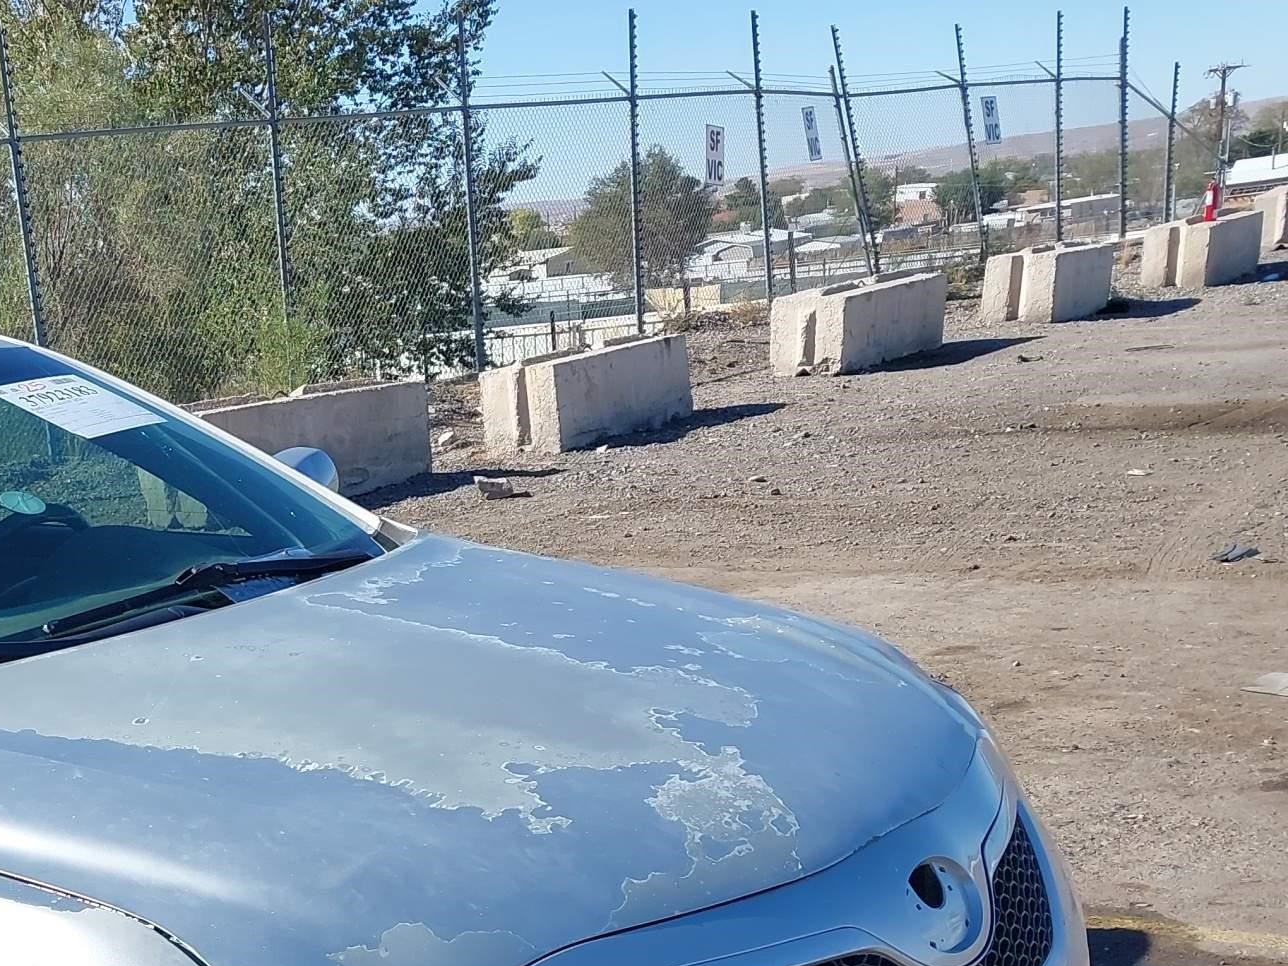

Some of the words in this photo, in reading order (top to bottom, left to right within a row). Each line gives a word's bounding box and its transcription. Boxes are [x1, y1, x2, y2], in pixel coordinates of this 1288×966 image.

[985, 100, 995, 118] SF
[805, 110, 815, 130] SF
[709, 130, 721, 152] SF
[985, 123, 1000, 141] VIC
[707, 158, 723, 181] VIC
[18, 385, 99, 407] 37923183
